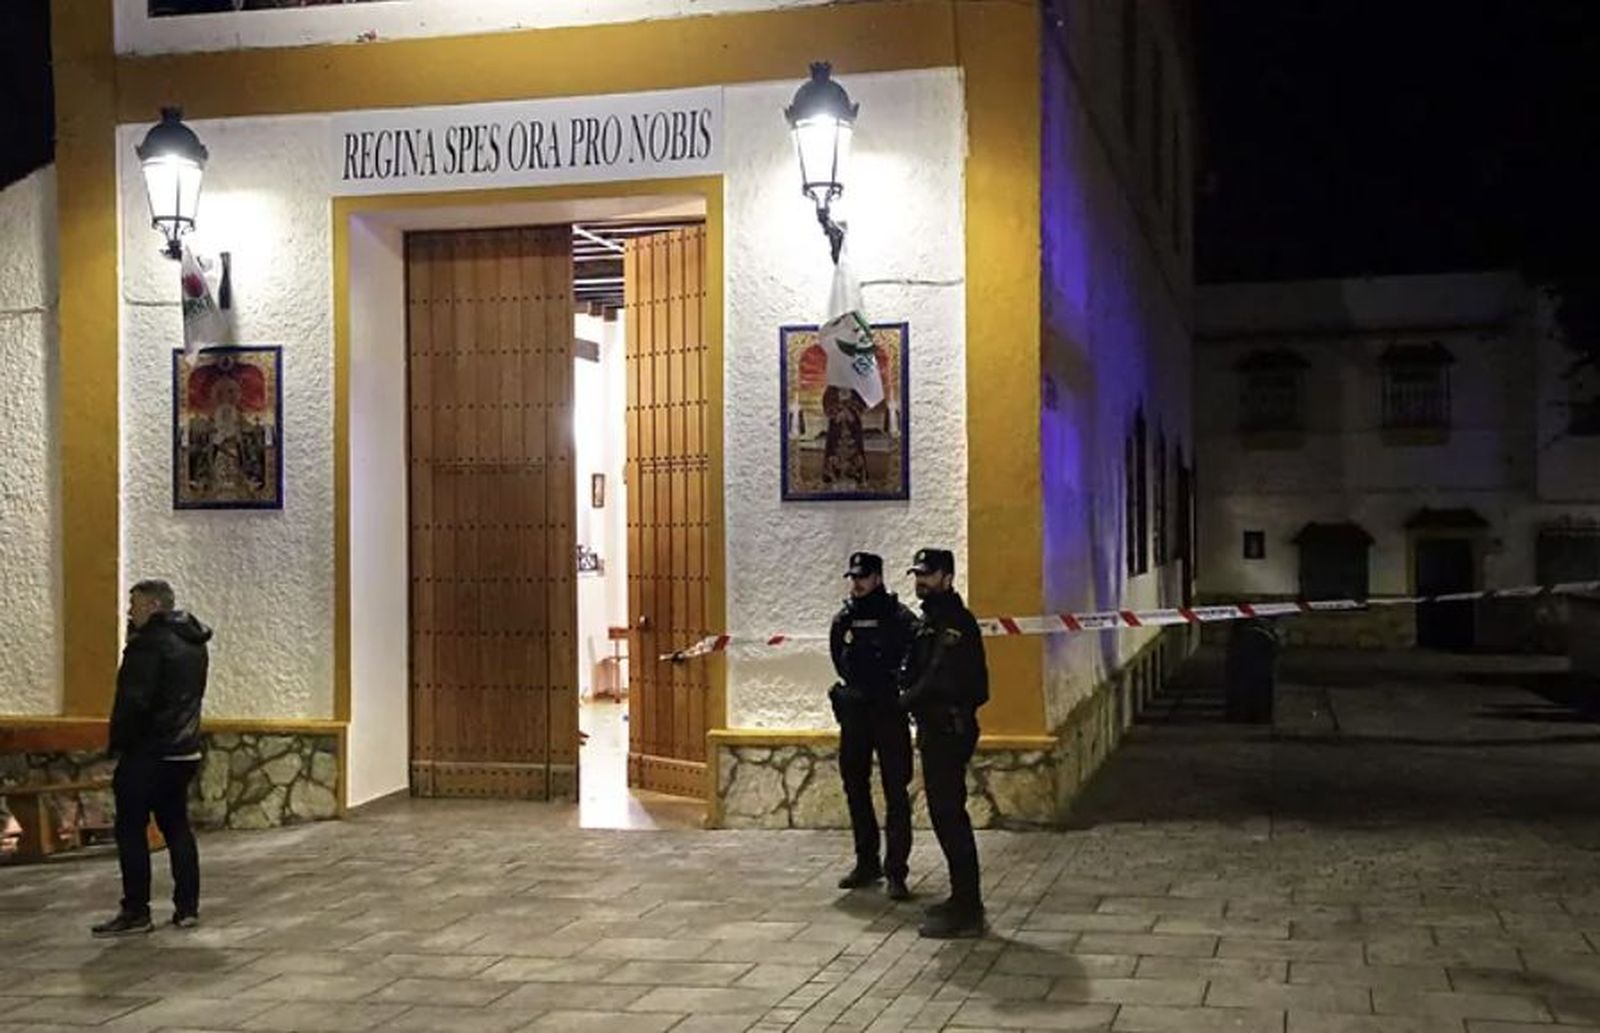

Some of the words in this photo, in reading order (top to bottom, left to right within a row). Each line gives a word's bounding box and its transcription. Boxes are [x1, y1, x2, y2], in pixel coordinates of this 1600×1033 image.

[342, 128, 437, 180] REGINA
[443, 122, 501, 174] SPES
[508, 120, 561, 171] ORA
[569, 115, 622, 166] PRO
[628, 107, 712, 163] NOBIS
